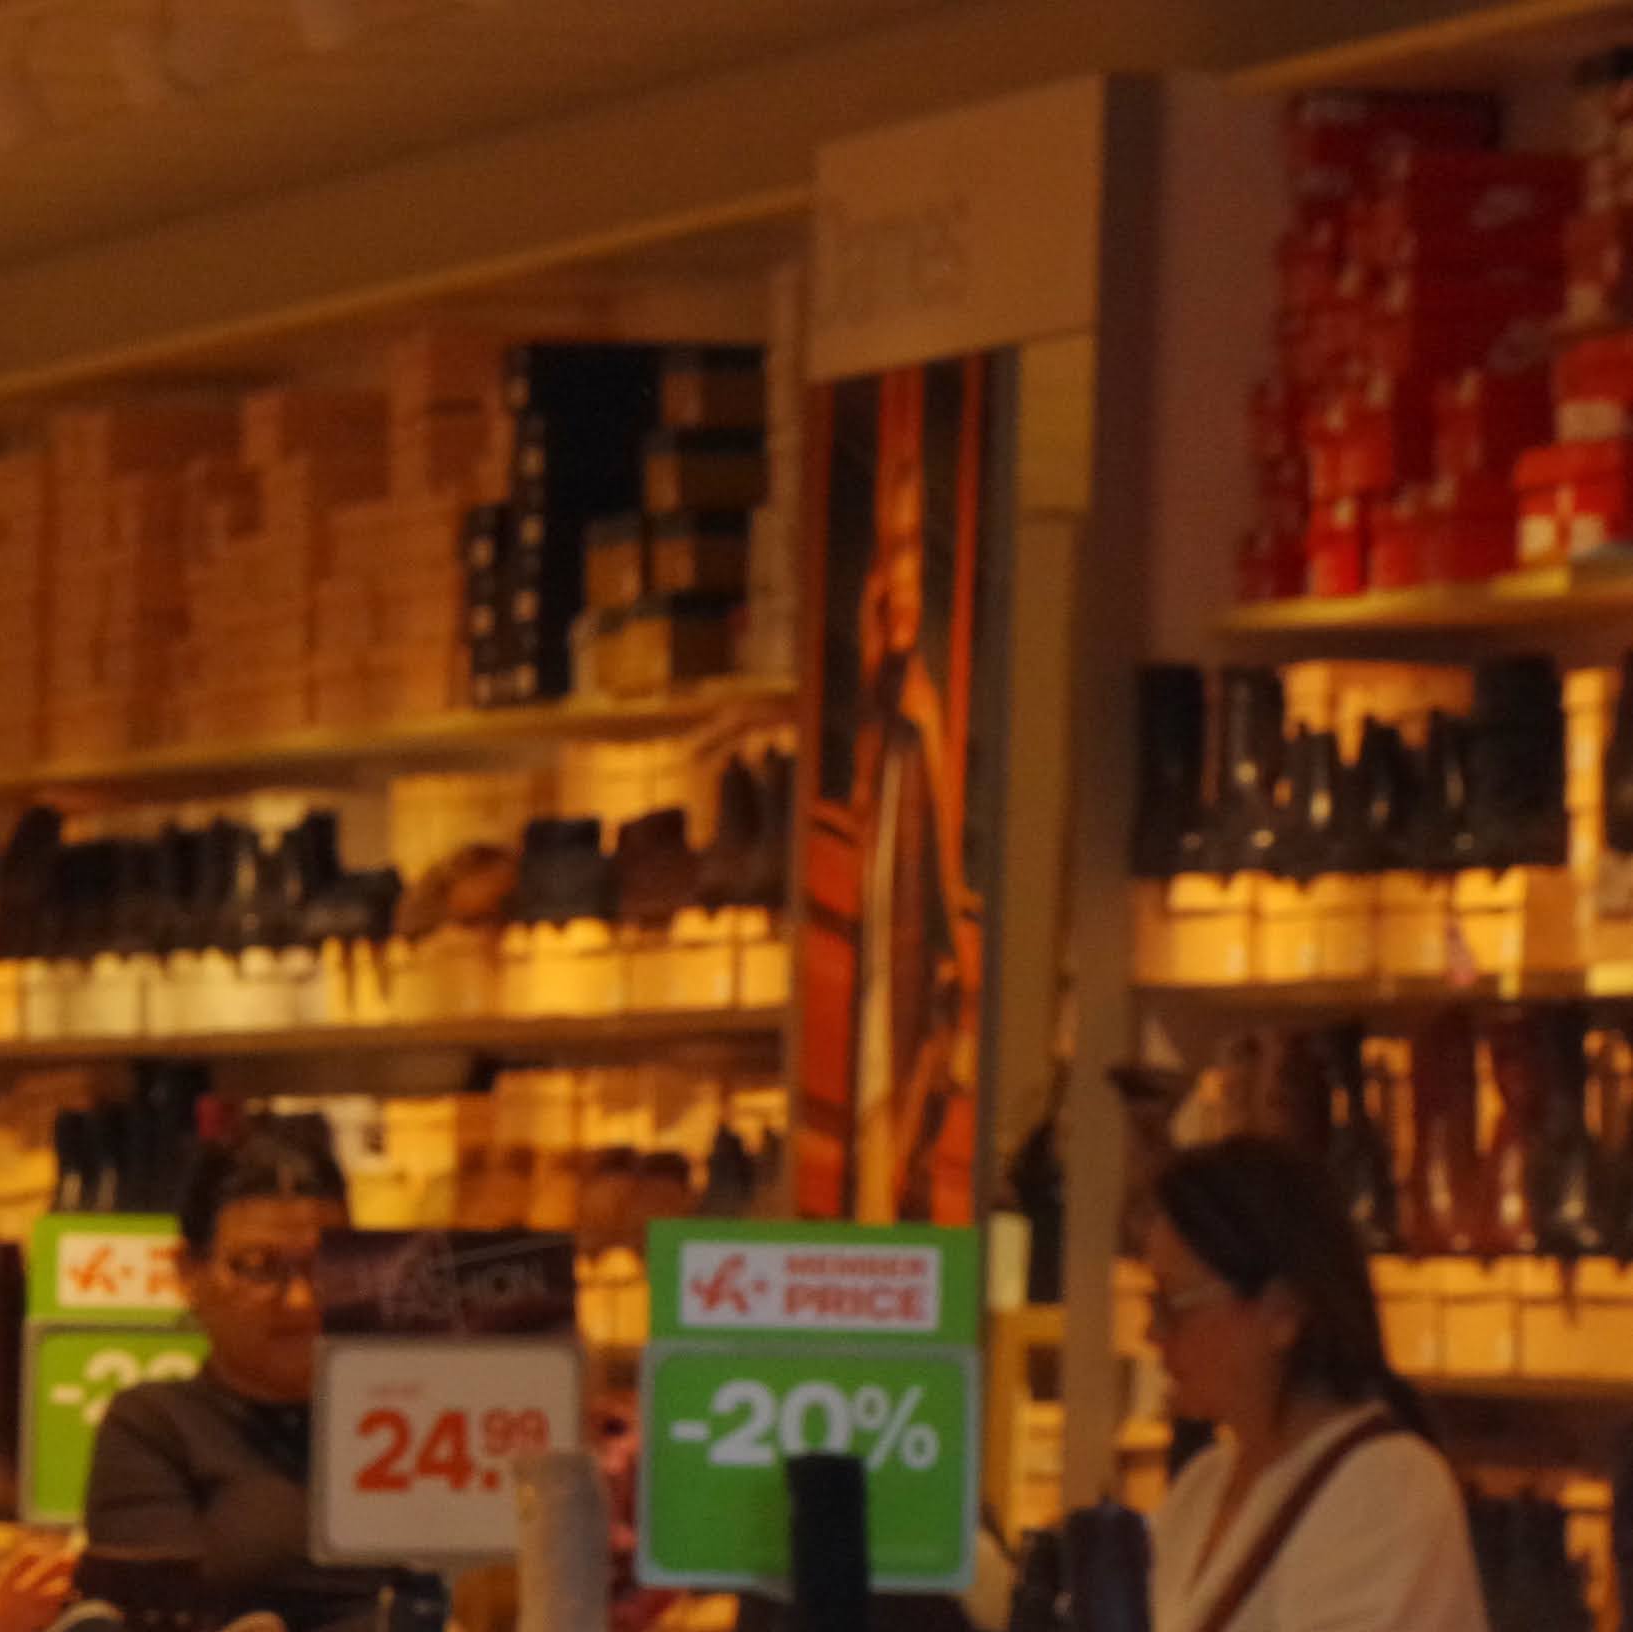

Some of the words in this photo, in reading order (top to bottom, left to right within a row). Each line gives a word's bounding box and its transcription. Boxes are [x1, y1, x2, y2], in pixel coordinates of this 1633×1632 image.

[783, 1282, 927, 1321] PRICE
[353, 1405, 552, 1493] 24.99
[671, 1380, 937, 1471] -20%
